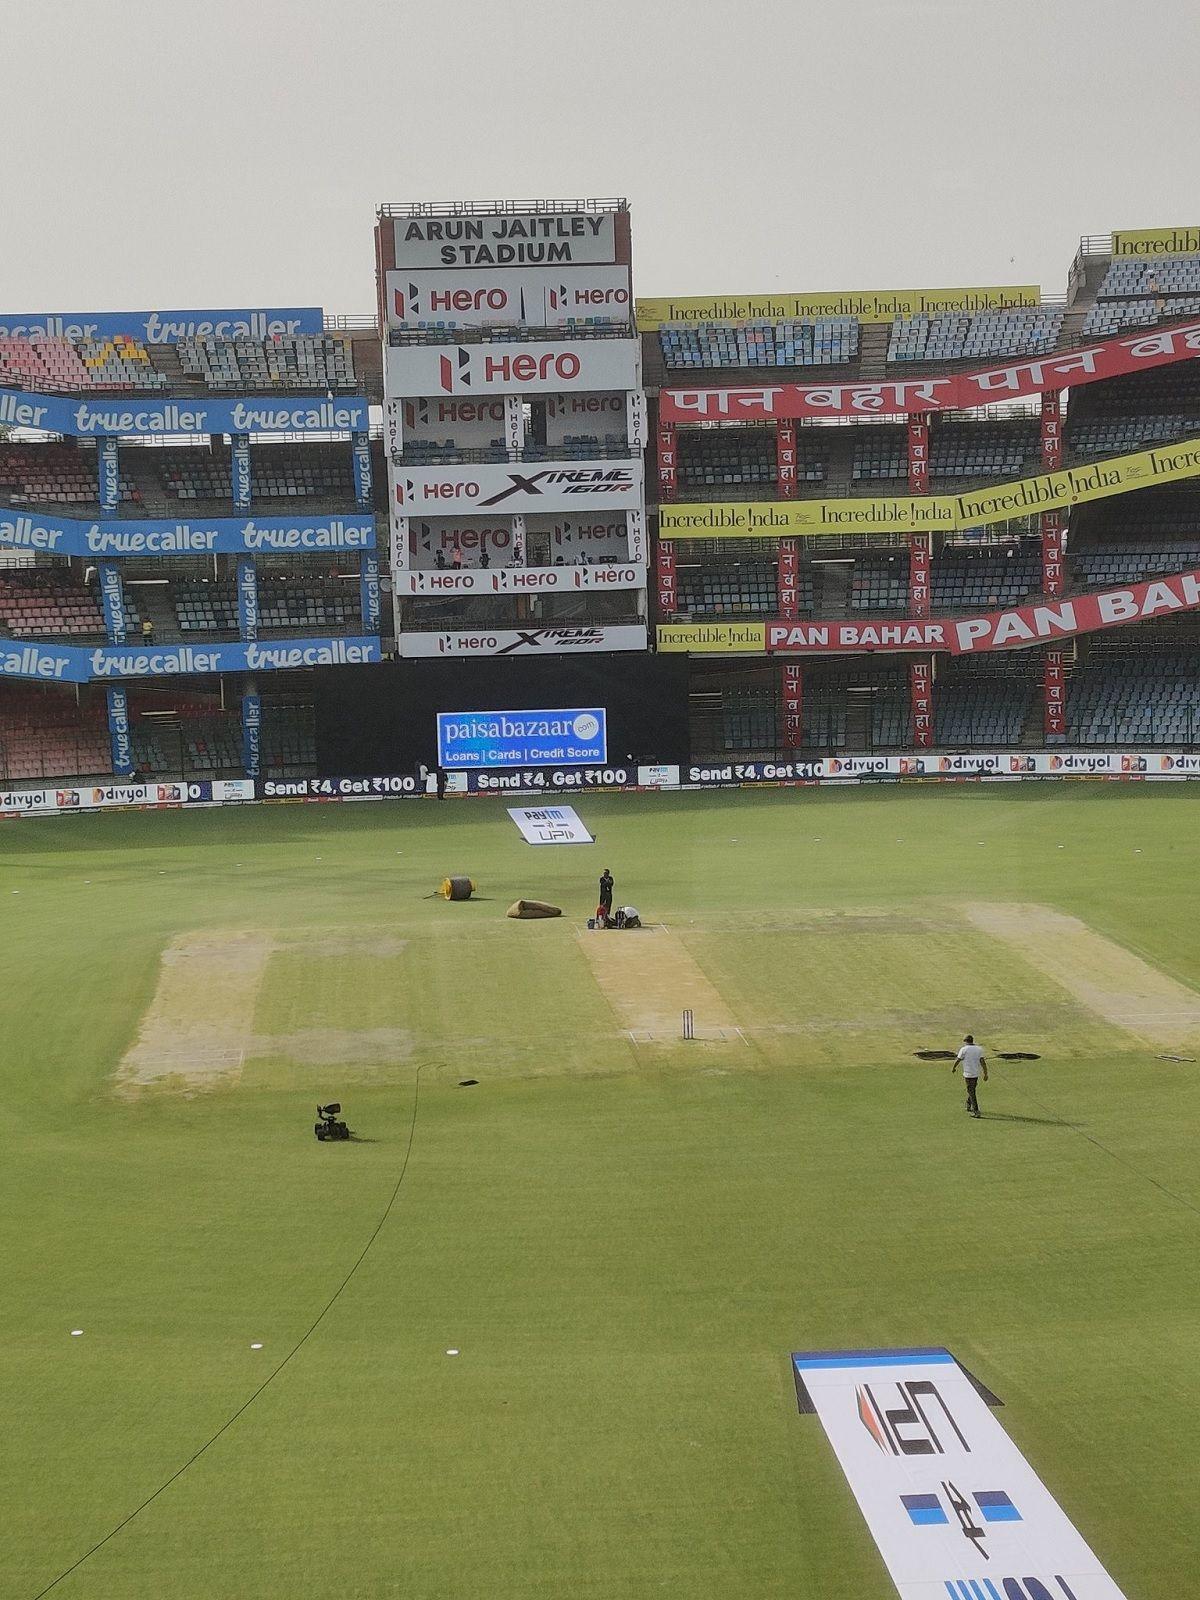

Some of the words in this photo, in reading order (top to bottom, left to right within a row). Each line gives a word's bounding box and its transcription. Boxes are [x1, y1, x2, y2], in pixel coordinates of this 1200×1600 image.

[404, 220, 483, 241] ARUN
[491, 216, 604, 238] JAITLEY
[440, 242, 572, 265] STADIUM
[1112, 230, 1200, 255] Incredib
[431, 289, 508, 311] Hero
[574, 288, 629, 305] Hero
[668, 302, 745, 321] Incredible
[794, 298, 871, 317] Incredible
[919, 294, 998, 313] Incredible
[485, 352, 581, 382] Hero
[664, 387, 785, 414] पान
[795, 379, 951, 412] बहार
[967, 348, 1107, 391] पान
[74, 405, 208, 431] truecaller
[230, 402, 363, 430] truecaller
[438, 401, 505, 422] Hero
[571, 396, 622, 413] Hero
[424, 482, 480, 499] Hero
[659, 508, 745, 528] Incredible
[820, 503, 908, 523] Incredible
[955, 476, 1068, 520] Incredible
[85, 524, 218, 552] truecaller
[240, 521, 372, 548] truecaller
[441, 528, 510, 549] Hero
[578, 523, 627, 540] Hero
[431, 575, 474, 589] Hero
[513, 572, 558, 587] Hero
[595, 569, 636, 583] Hero
[658, 626, 727, 644] Incredible
[769, 627, 829, 646] PAN
[840, 625, 945, 645] BAHAR
[955, 602, 1078, 651] PAN
[458, 637, 497, 649] Hero
[89, 648, 222, 676] truecaller
[244, 641, 373, 670] truecaller
[110, 692, 130, 768] truecaller
[446, 717, 573, 744] paisabazaar
[446, 751, 479, 761] Loans
[488, 749, 522, 760] Cards
[530, 748, 564, 759] Credit
[567, 747, 600, 757] Score
[1064, 755, 1110, 772] divyol
[477, 772, 520, 789] Send
[552, 770, 583, 786] Get
[584, 769, 627, 785] ₹100
[689, 765, 732, 782] Send
[763, 763, 793, 779] Get
[4, 791, 46, 809] divyol
[106, 785, 147, 803] divyol
[264, 780, 307, 796] Send
[339, 779, 371, 793] Get
[372, 776, 415, 792] ₹100
